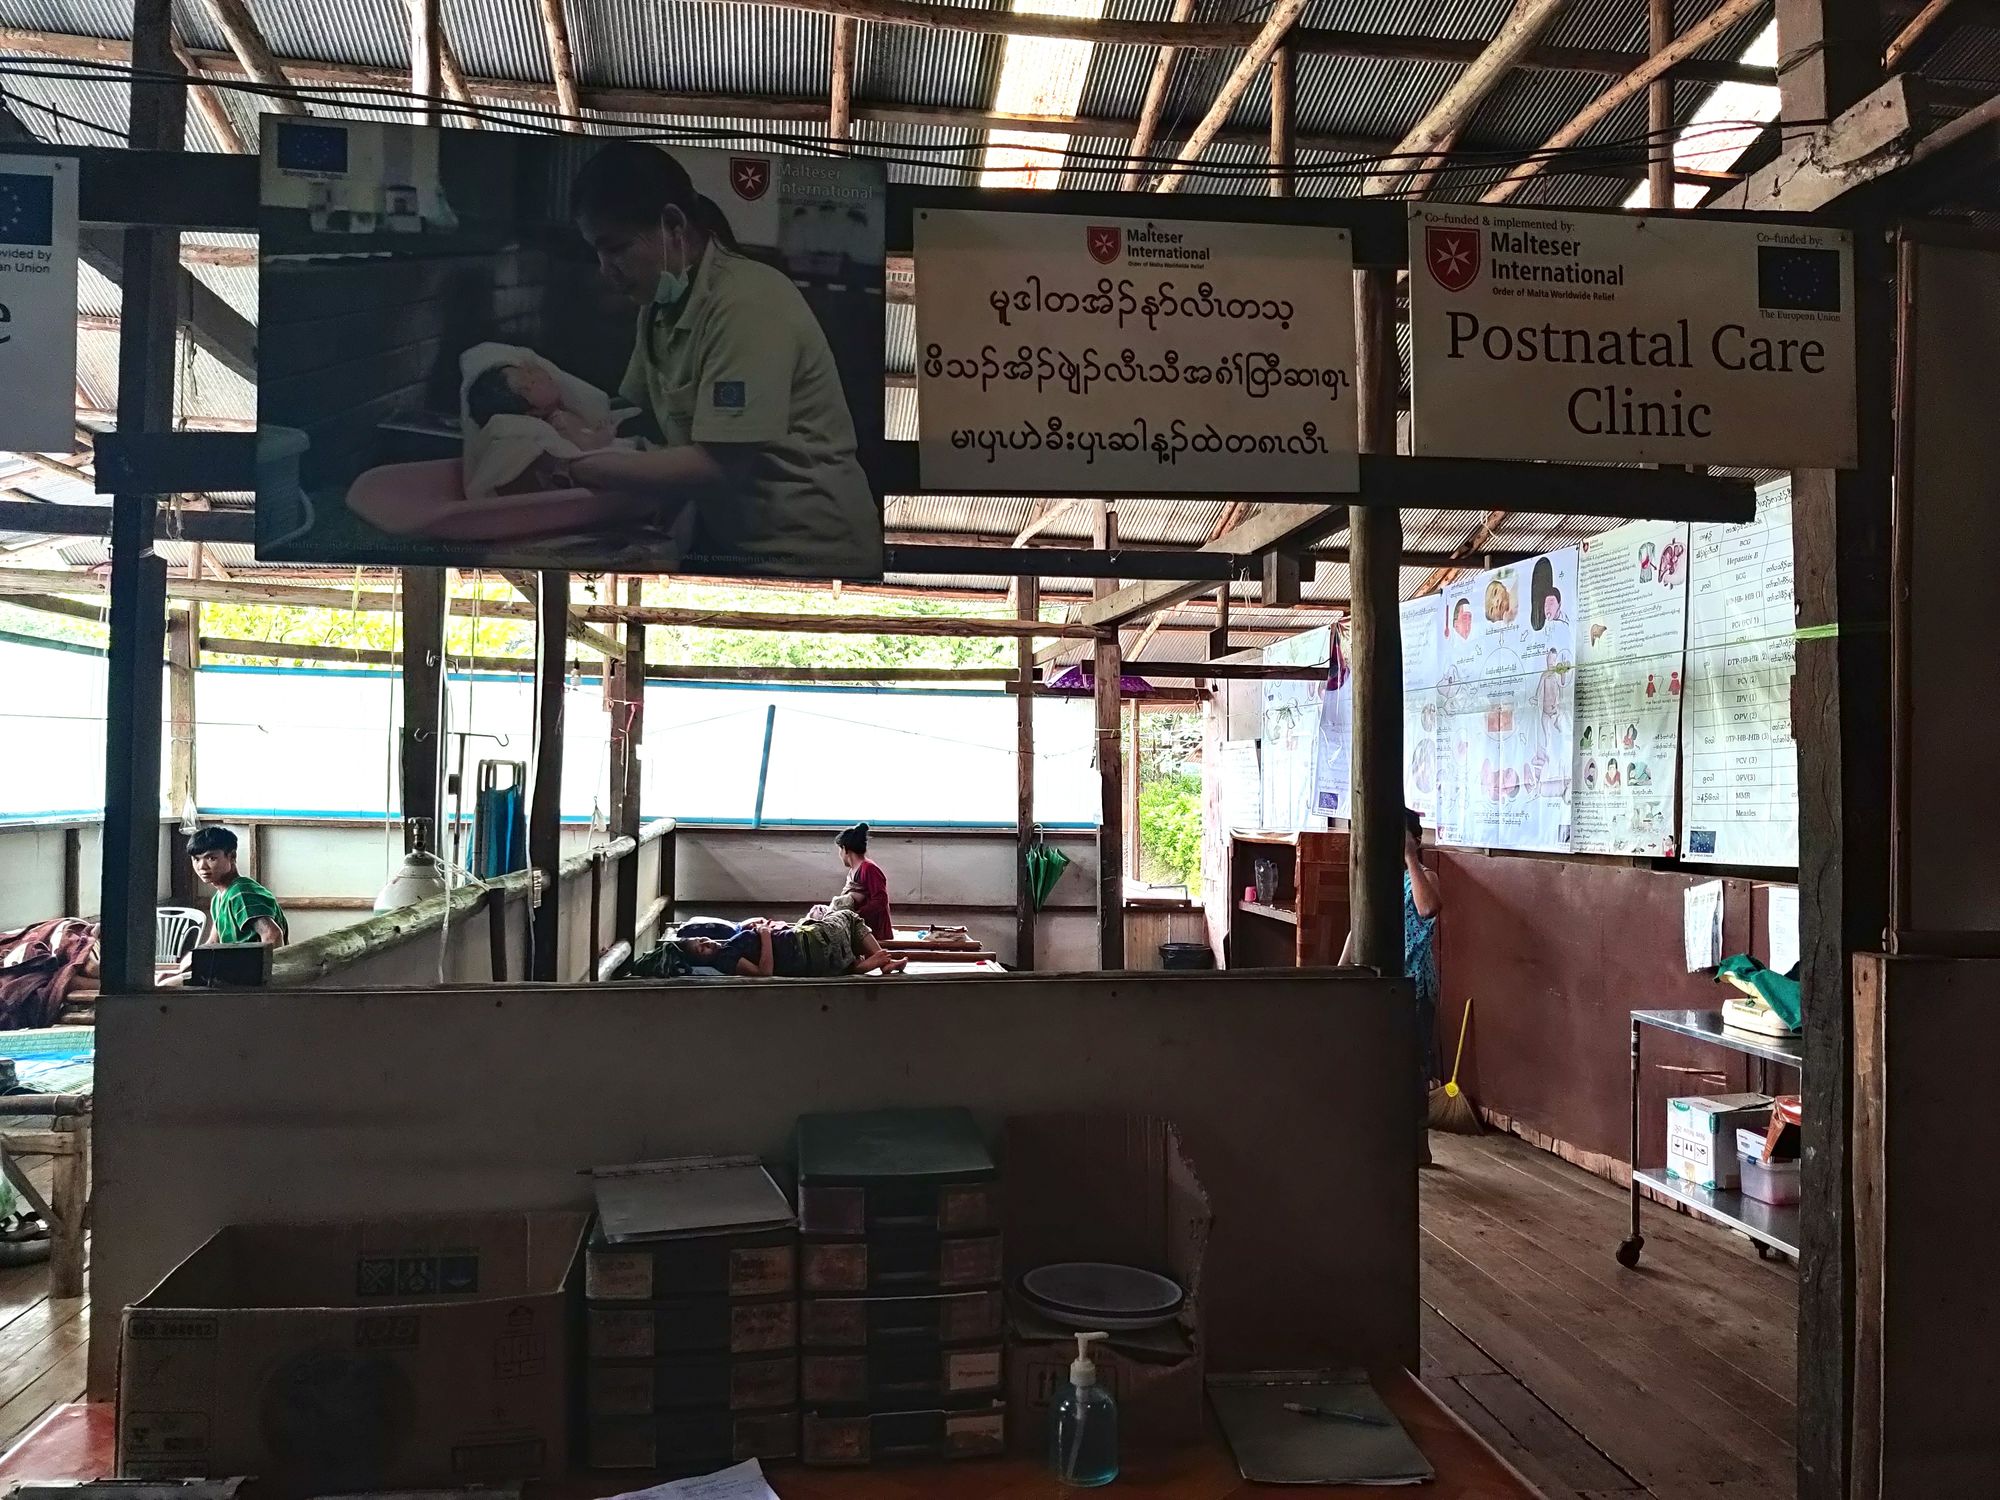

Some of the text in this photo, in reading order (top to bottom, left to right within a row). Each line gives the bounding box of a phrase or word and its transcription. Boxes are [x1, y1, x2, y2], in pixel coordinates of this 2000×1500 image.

[777, 162, 841, 180] Malteser
[777, 180, 873, 200] International
[1481, 216, 1491, 226] &
[1493, 216, 1558, 232] implemented
[1127, 228, 1184, 244] Malteser
[1490, 231, 1581, 257] Malteser
[37, 250, 52, 262] by
[1127, 245, 1210, 261] International
[15, 262, 50, 273] Union
[1491, 259, 1624, 286] International
[1492, 287, 1615, 302] Order of Malta Worldwide Relief
[1760, 309, 1841, 322] The European Union
[1445, 310, 1826, 375] Postnatal Care
[1568, 385, 1713, 438] Clinic
[1733, 712, 1748, 721] OPV
[1735, 791, 1751, 800] MMR
